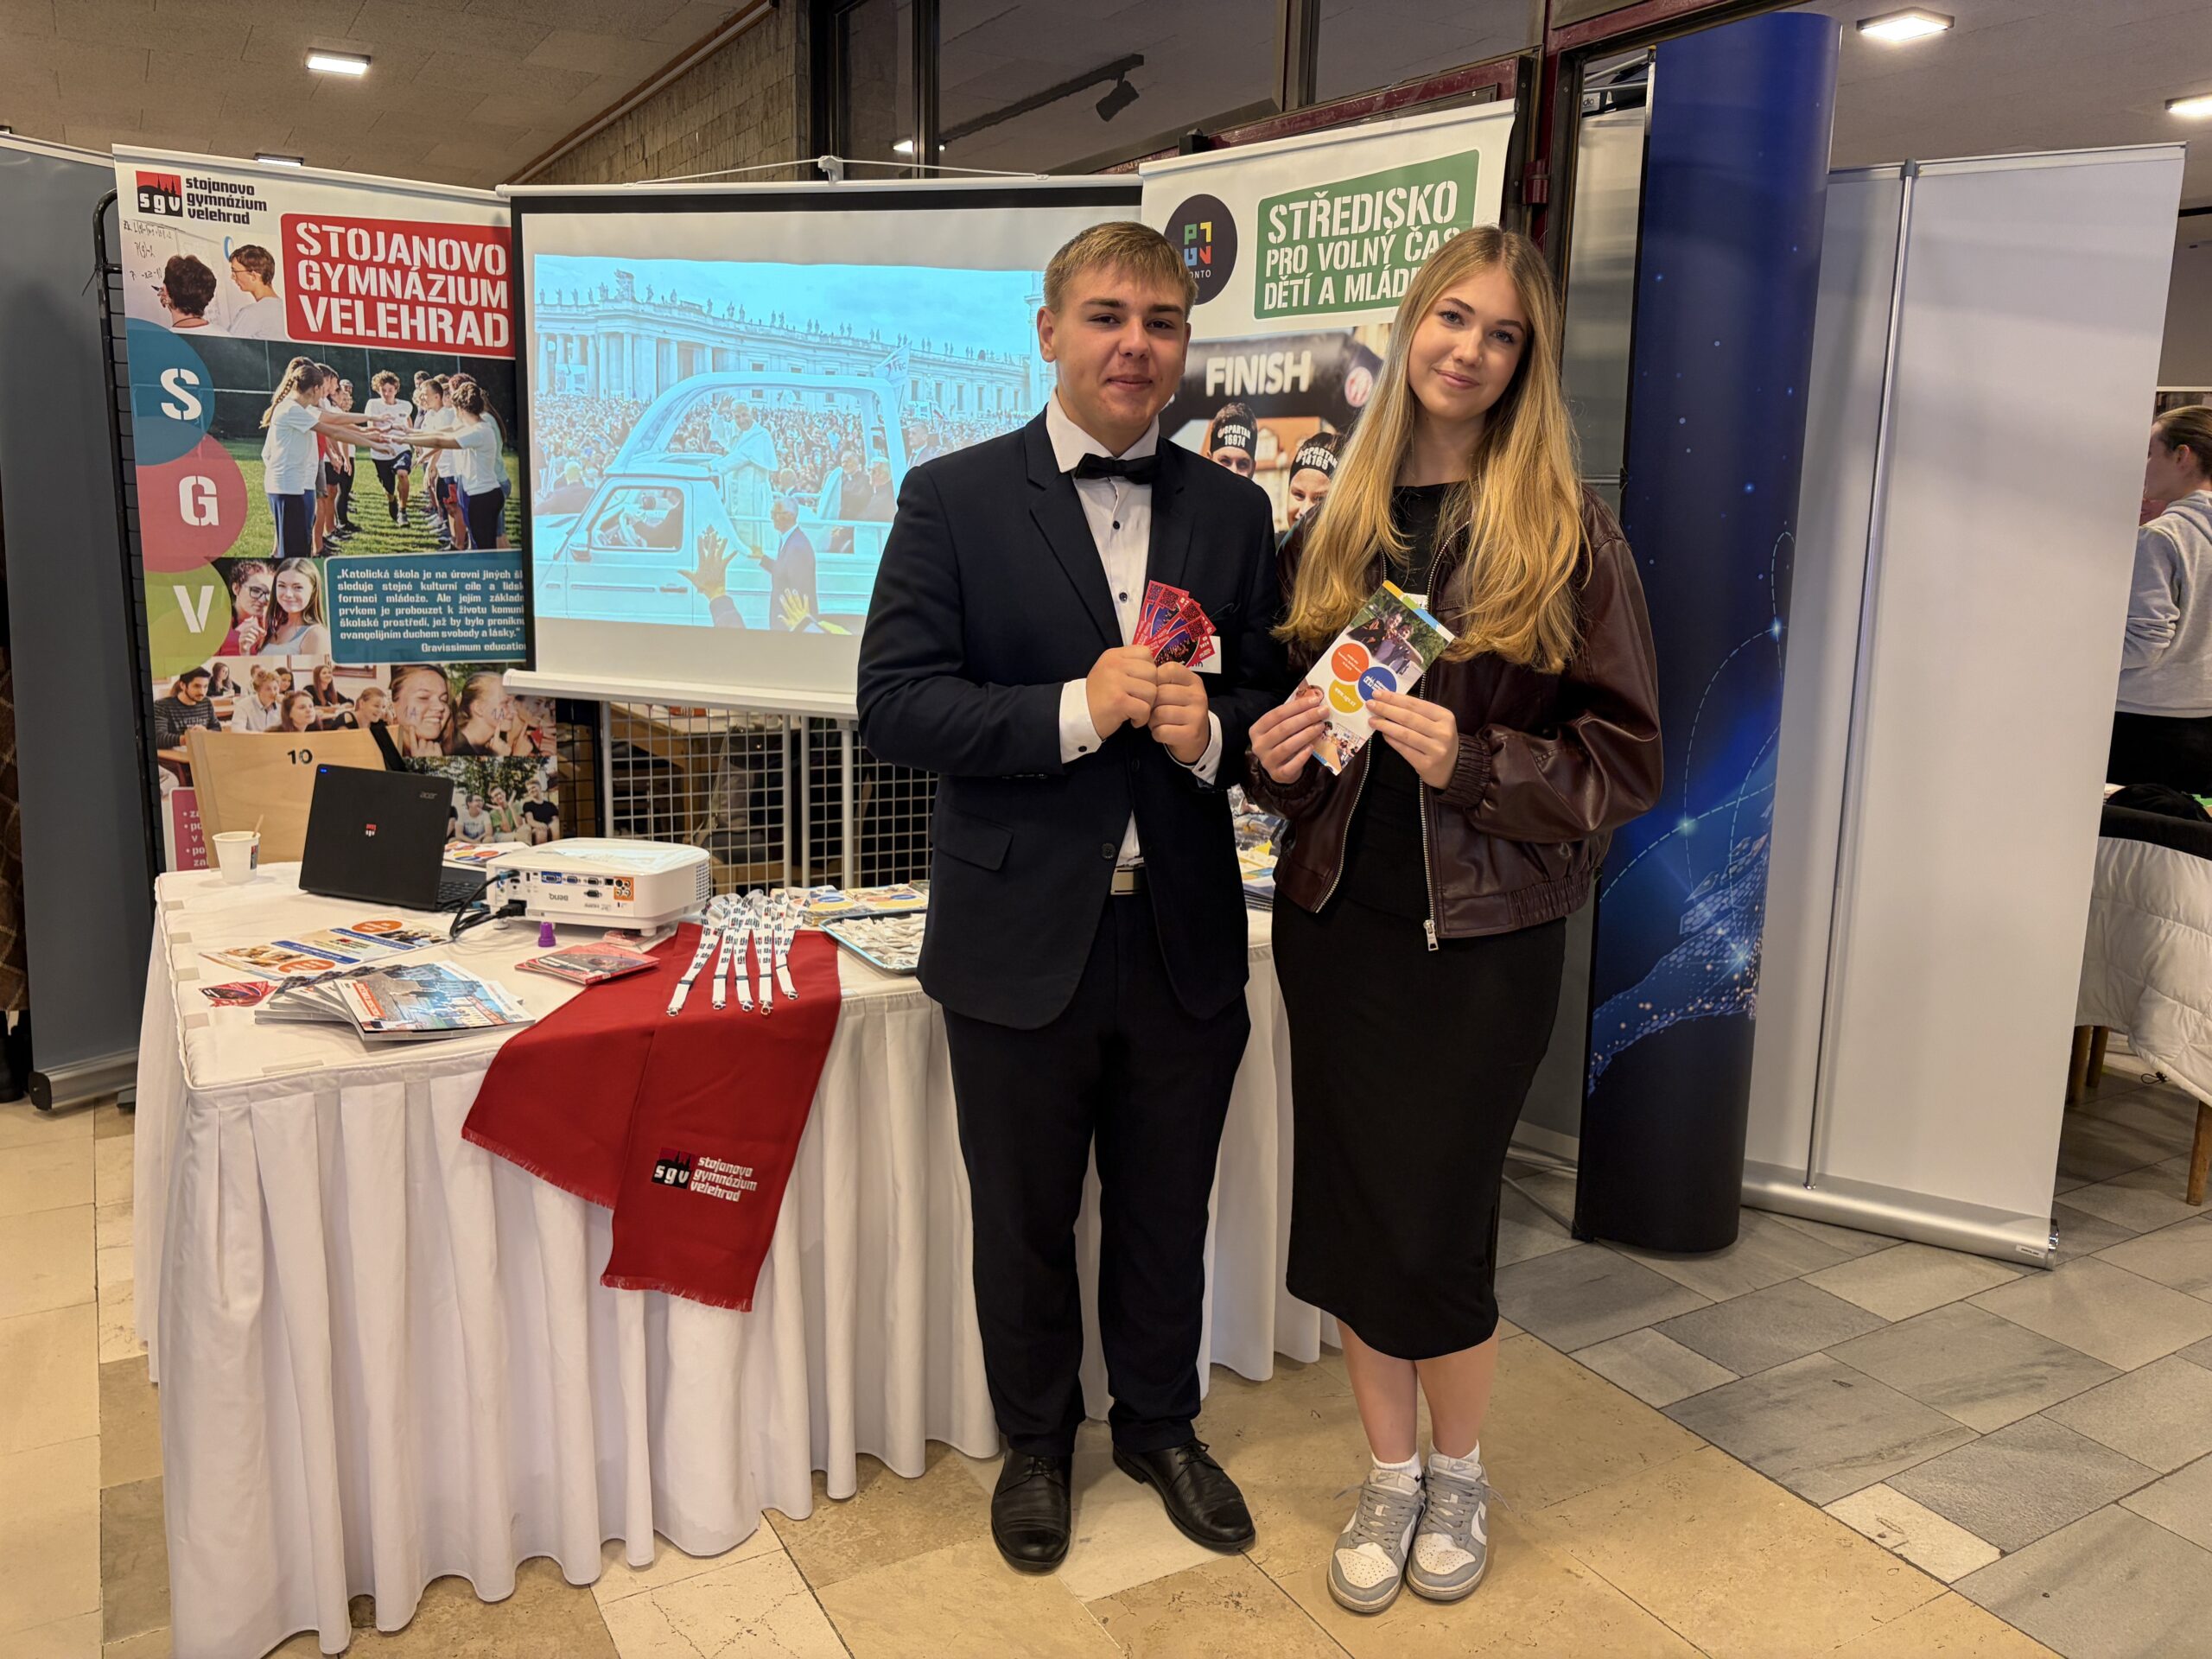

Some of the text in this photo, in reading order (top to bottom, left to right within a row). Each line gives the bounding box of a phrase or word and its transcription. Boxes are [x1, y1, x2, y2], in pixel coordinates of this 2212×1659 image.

[186, 176, 255, 196] stojanovo
[139, 193, 181, 214] sgv
[187, 192, 268, 212] gymnázium
[188, 207, 251, 226] velehrad
[1268, 180, 1459, 245] STŘEDISKO
[296, 221, 506, 276] STOJANOVO
[1266, 245, 1308, 277] PRO
[1318, 228, 1396, 271] VOLNÝ
[297, 259, 508, 309] GYMNÁZIUM
[1189, 269, 1211, 279] ONTO
[1263, 264, 1423, 311] DĚTÍ A MLÁD
[298, 295, 509, 347] VELEHRAD
[1206, 350, 1313, 397] FINISH
[160, 368, 202, 421] S
[178, 475, 219, 526] G
[393, 569, 420, 579] škola
[423, 569, 432, 581] je
[482, 569, 511, 581] jiných
[337, 582, 373, 593] sleduje
[382, 582, 413, 592] stejné
[420, 582, 457, 591] kulturní
[338, 594, 378, 603] formaci
[436, 593, 451, 603] Ale
[459, 594, 481, 604] jejím
[173, 586, 214, 632] V
[339, 606, 376, 617] prvkem
[381, 606, 390, 617] je
[395, 605, 442, 616] probouzet
[448, 605, 454, 614] k
[459, 605, 486, 614] životu
[340, 618, 378, 627] školské
[450, 616, 461, 627] by
[465, 616, 484, 626] bylo
[403, 629, 439, 639] duchem
[442, 628, 479, 639] svobody
[421, 643, 480, 652] Gravissimum
[287, 749, 313, 765] 10
[654, 1165, 690, 1185] sgv
[698, 1157, 753, 1177] stojanovo
[693, 1169, 758, 1192] gymnázium
[690, 1180, 741, 1202] velehrad
